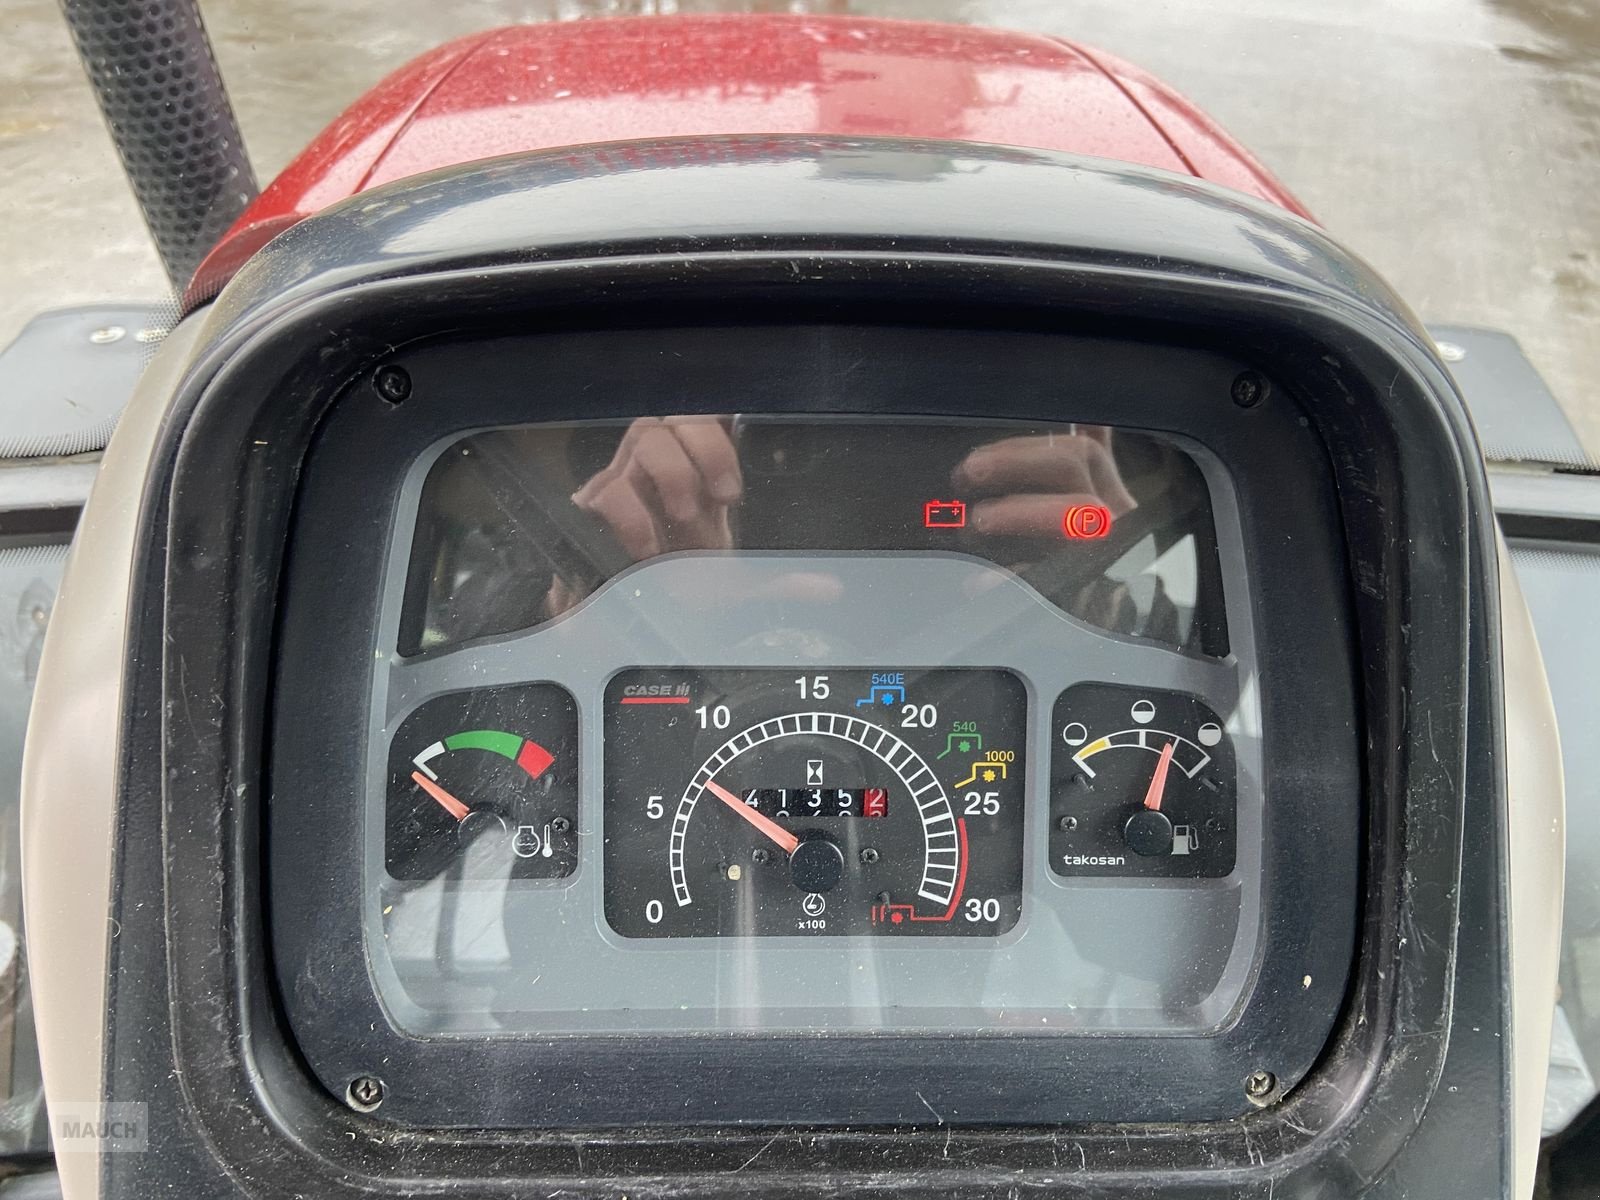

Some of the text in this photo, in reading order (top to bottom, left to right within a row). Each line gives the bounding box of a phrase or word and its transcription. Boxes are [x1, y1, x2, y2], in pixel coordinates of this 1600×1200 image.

[1081, 511, 1096, 532] P
[795, 676, 830, 700] 15
[871, 673, 905, 685] 540E
[623, 685, 672, 697] CASE
[695, 705, 731, 729] 10
[901, 704, 938, 728] 20
[952, 721, 977, 732] 540
[984, 750, 1015, 762] 1000
[646, 796, 664, 819] 5
[964, 791, 1000, 815] 25
[1063, 854, 1125, 866] takosan
[645, 900, 664, 924] 0
[965, 898, 1000, 922] 30
[798, 919, 826, 930] x100
